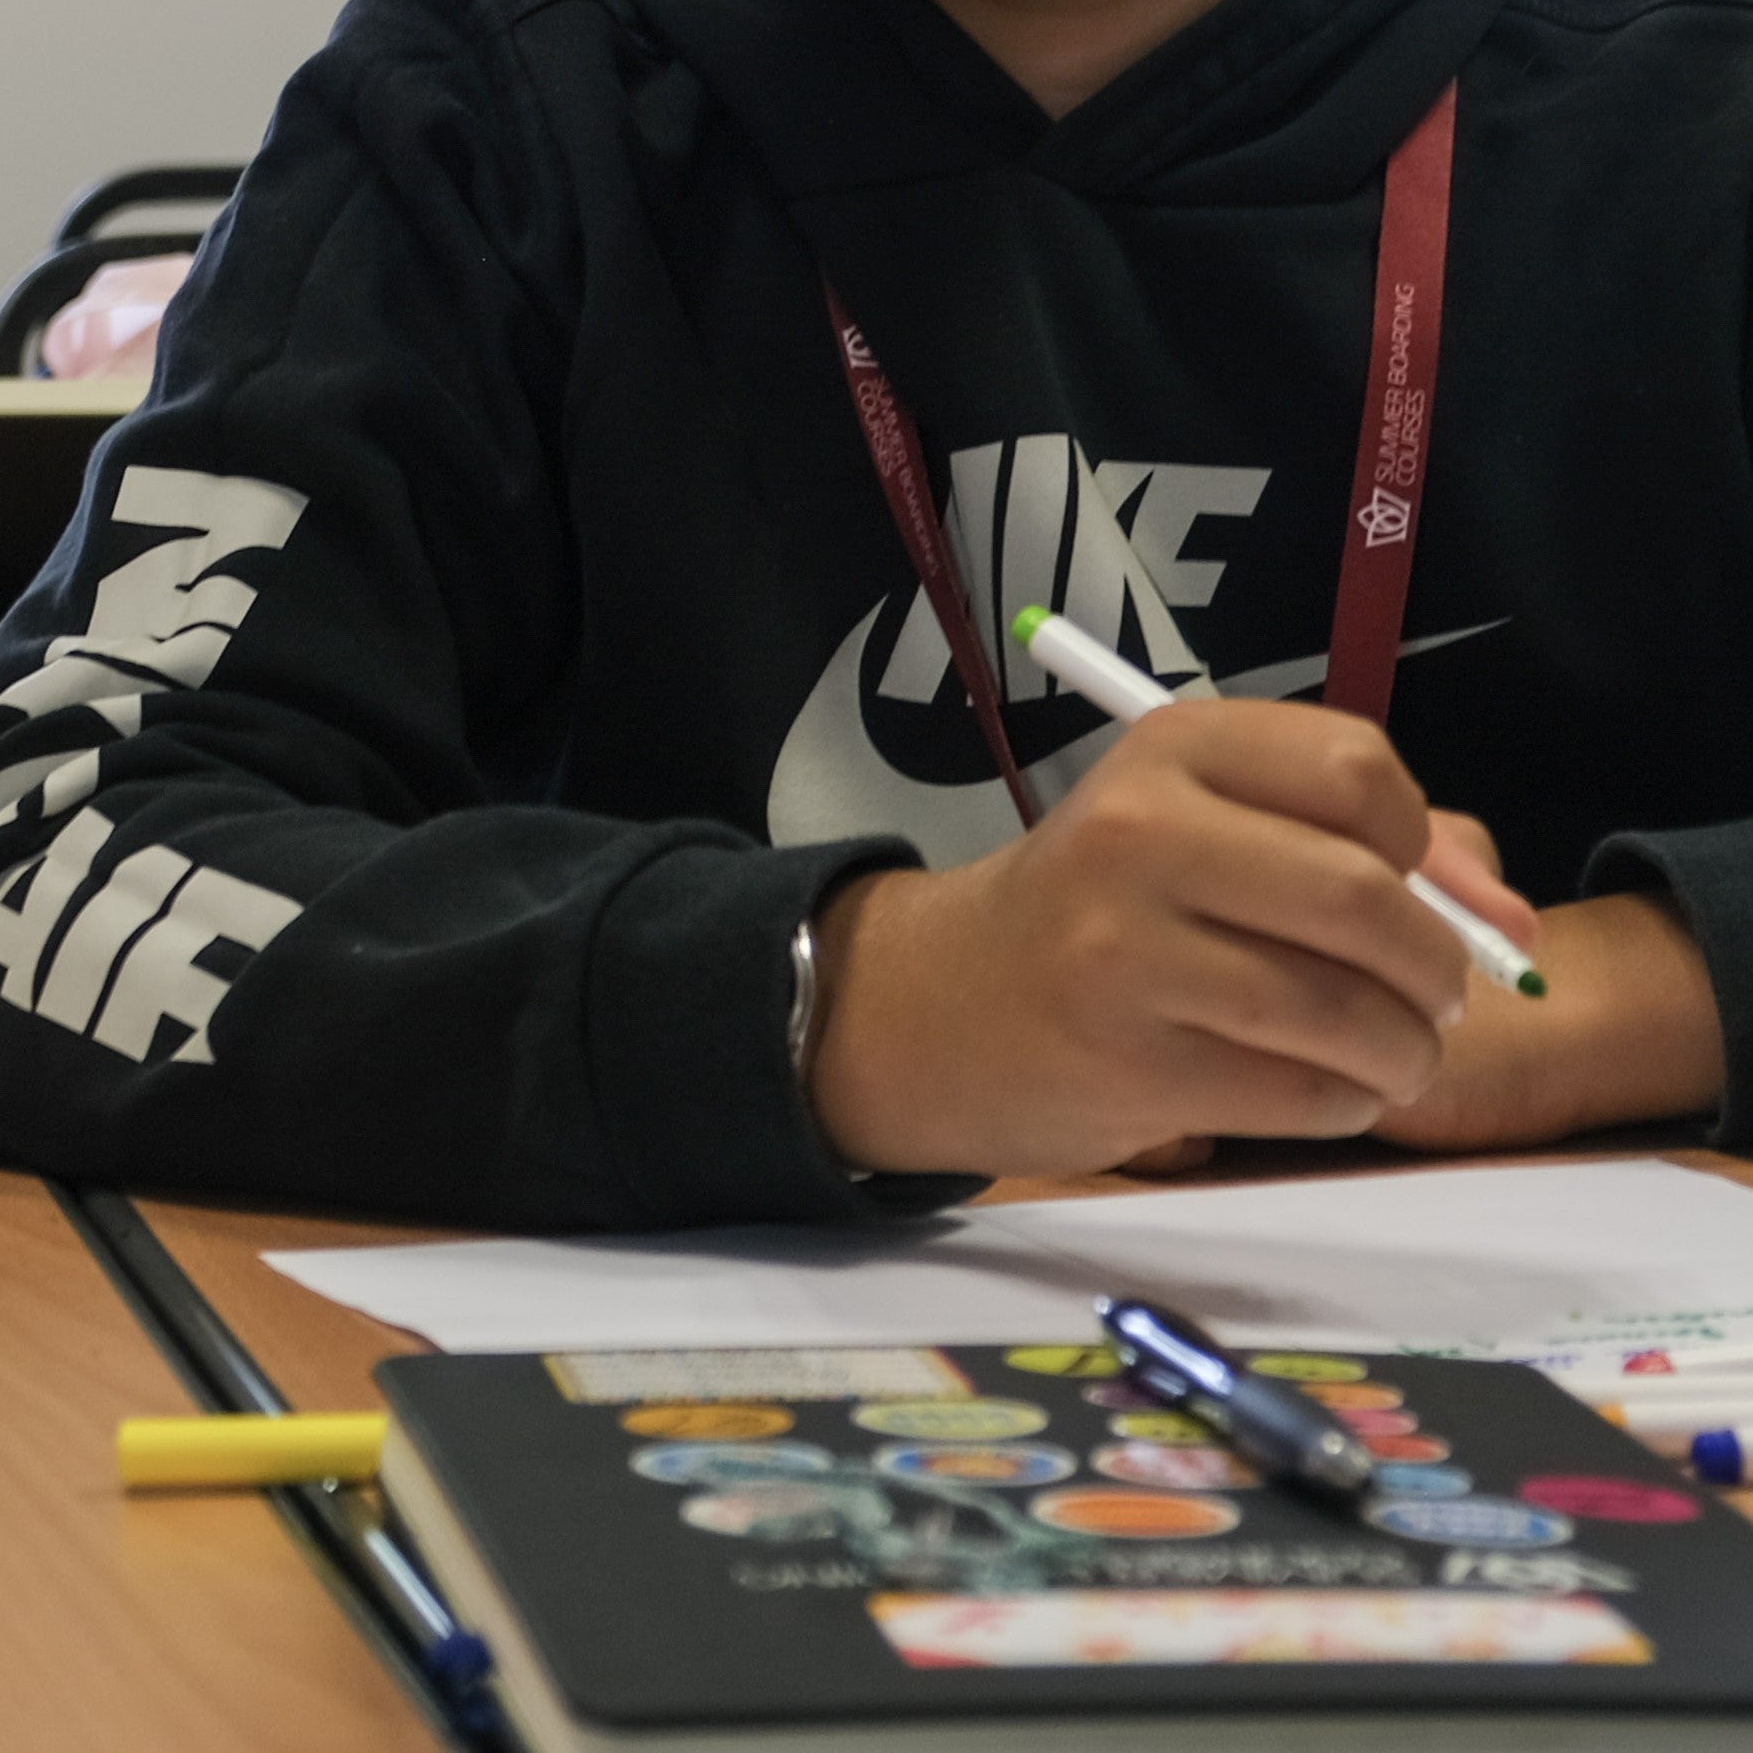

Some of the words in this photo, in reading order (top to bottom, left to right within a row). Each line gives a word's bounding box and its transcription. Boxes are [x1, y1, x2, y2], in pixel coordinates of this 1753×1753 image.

[1387, 283, 1414, 385] BOARDING
[857, 381, 894, 477] COURSES
[1375, 388, 1403, 484] SUMMER
[1396, 388, 1425, 487] COURSES
[877, 432, 1273, 704] NIKE
